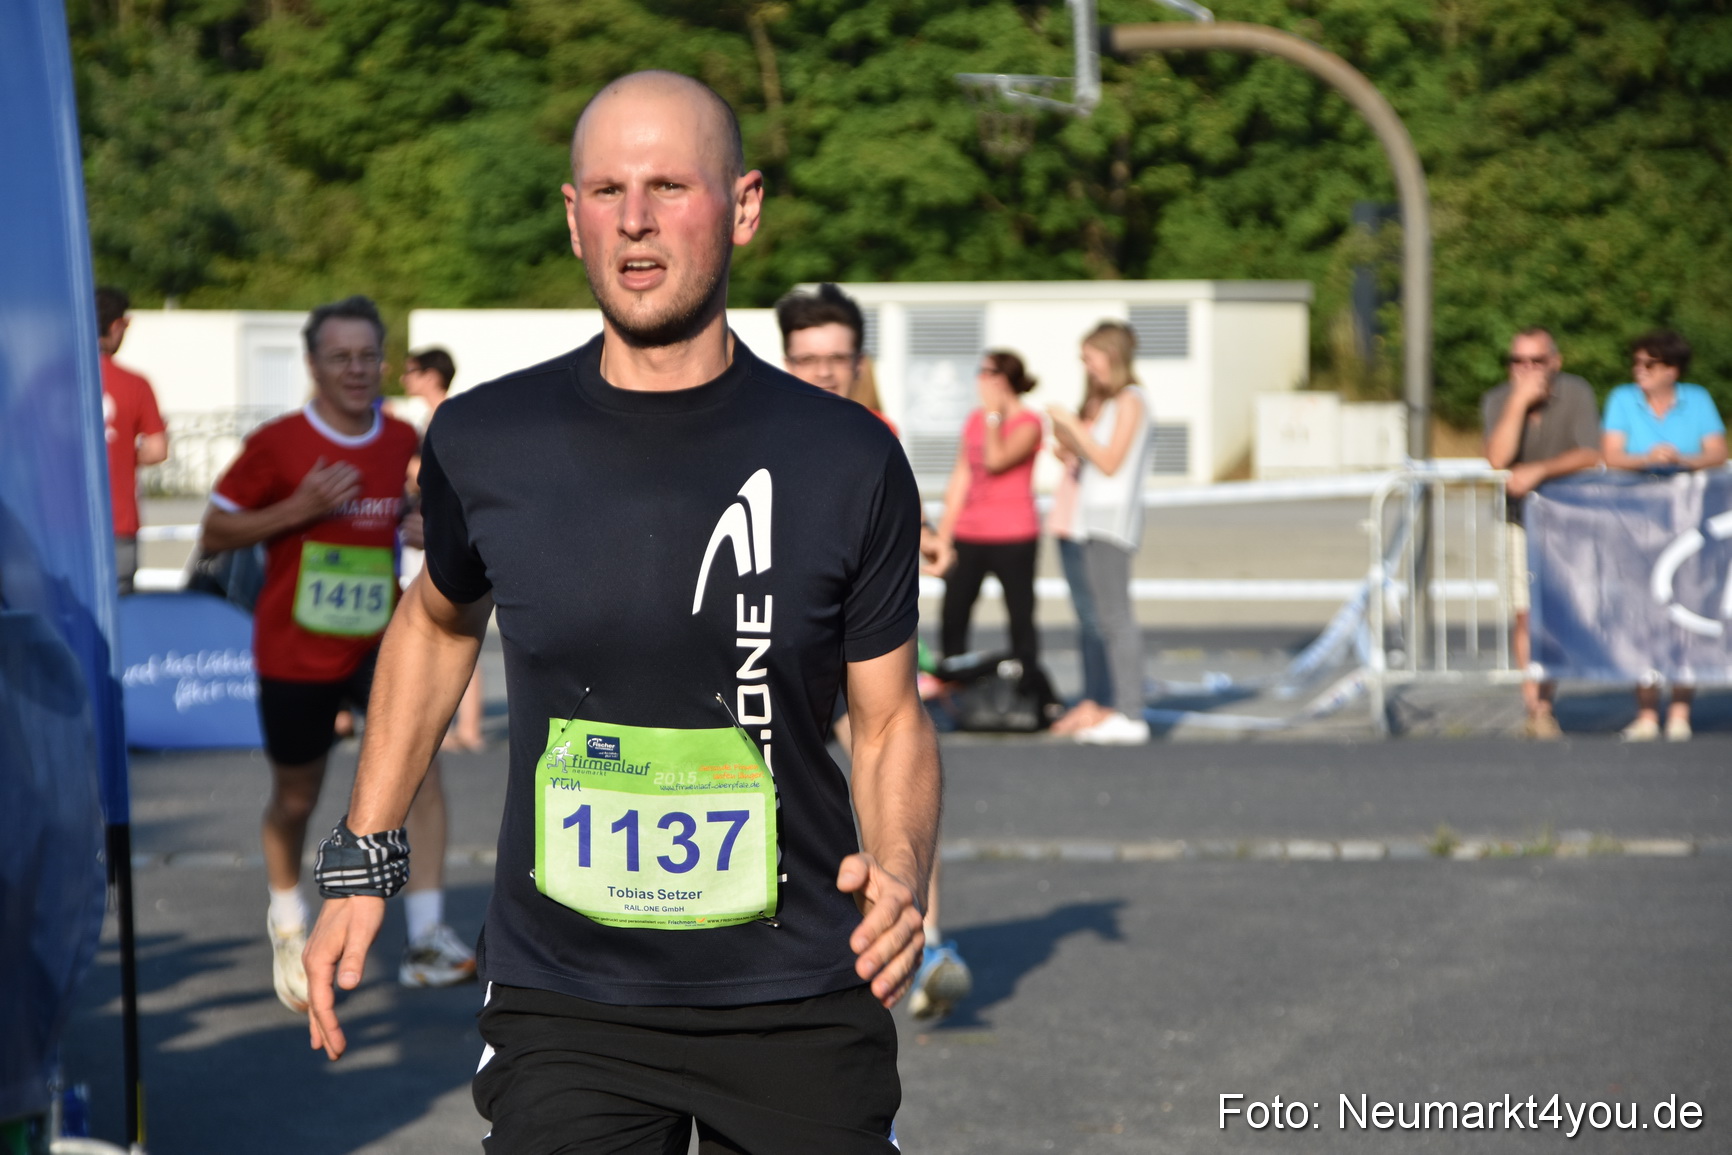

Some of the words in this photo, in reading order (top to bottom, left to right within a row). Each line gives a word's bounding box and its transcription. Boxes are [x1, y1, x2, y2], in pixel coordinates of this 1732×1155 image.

[309, 579, 385, 614] 1415
[572, 754, 651, 776] firmenlauf
[572, 768, 607, 776] neumarkt
[653, 771, 697, 785] 2015
[563, 804, 750, 874] 1137
[607, 886, 655, 900] Tobias
[657, 888, 703, 901] Setzer
[624, 904, 660, 912] RAIL.ONE
[661, 905, 685, 913] GmbH
